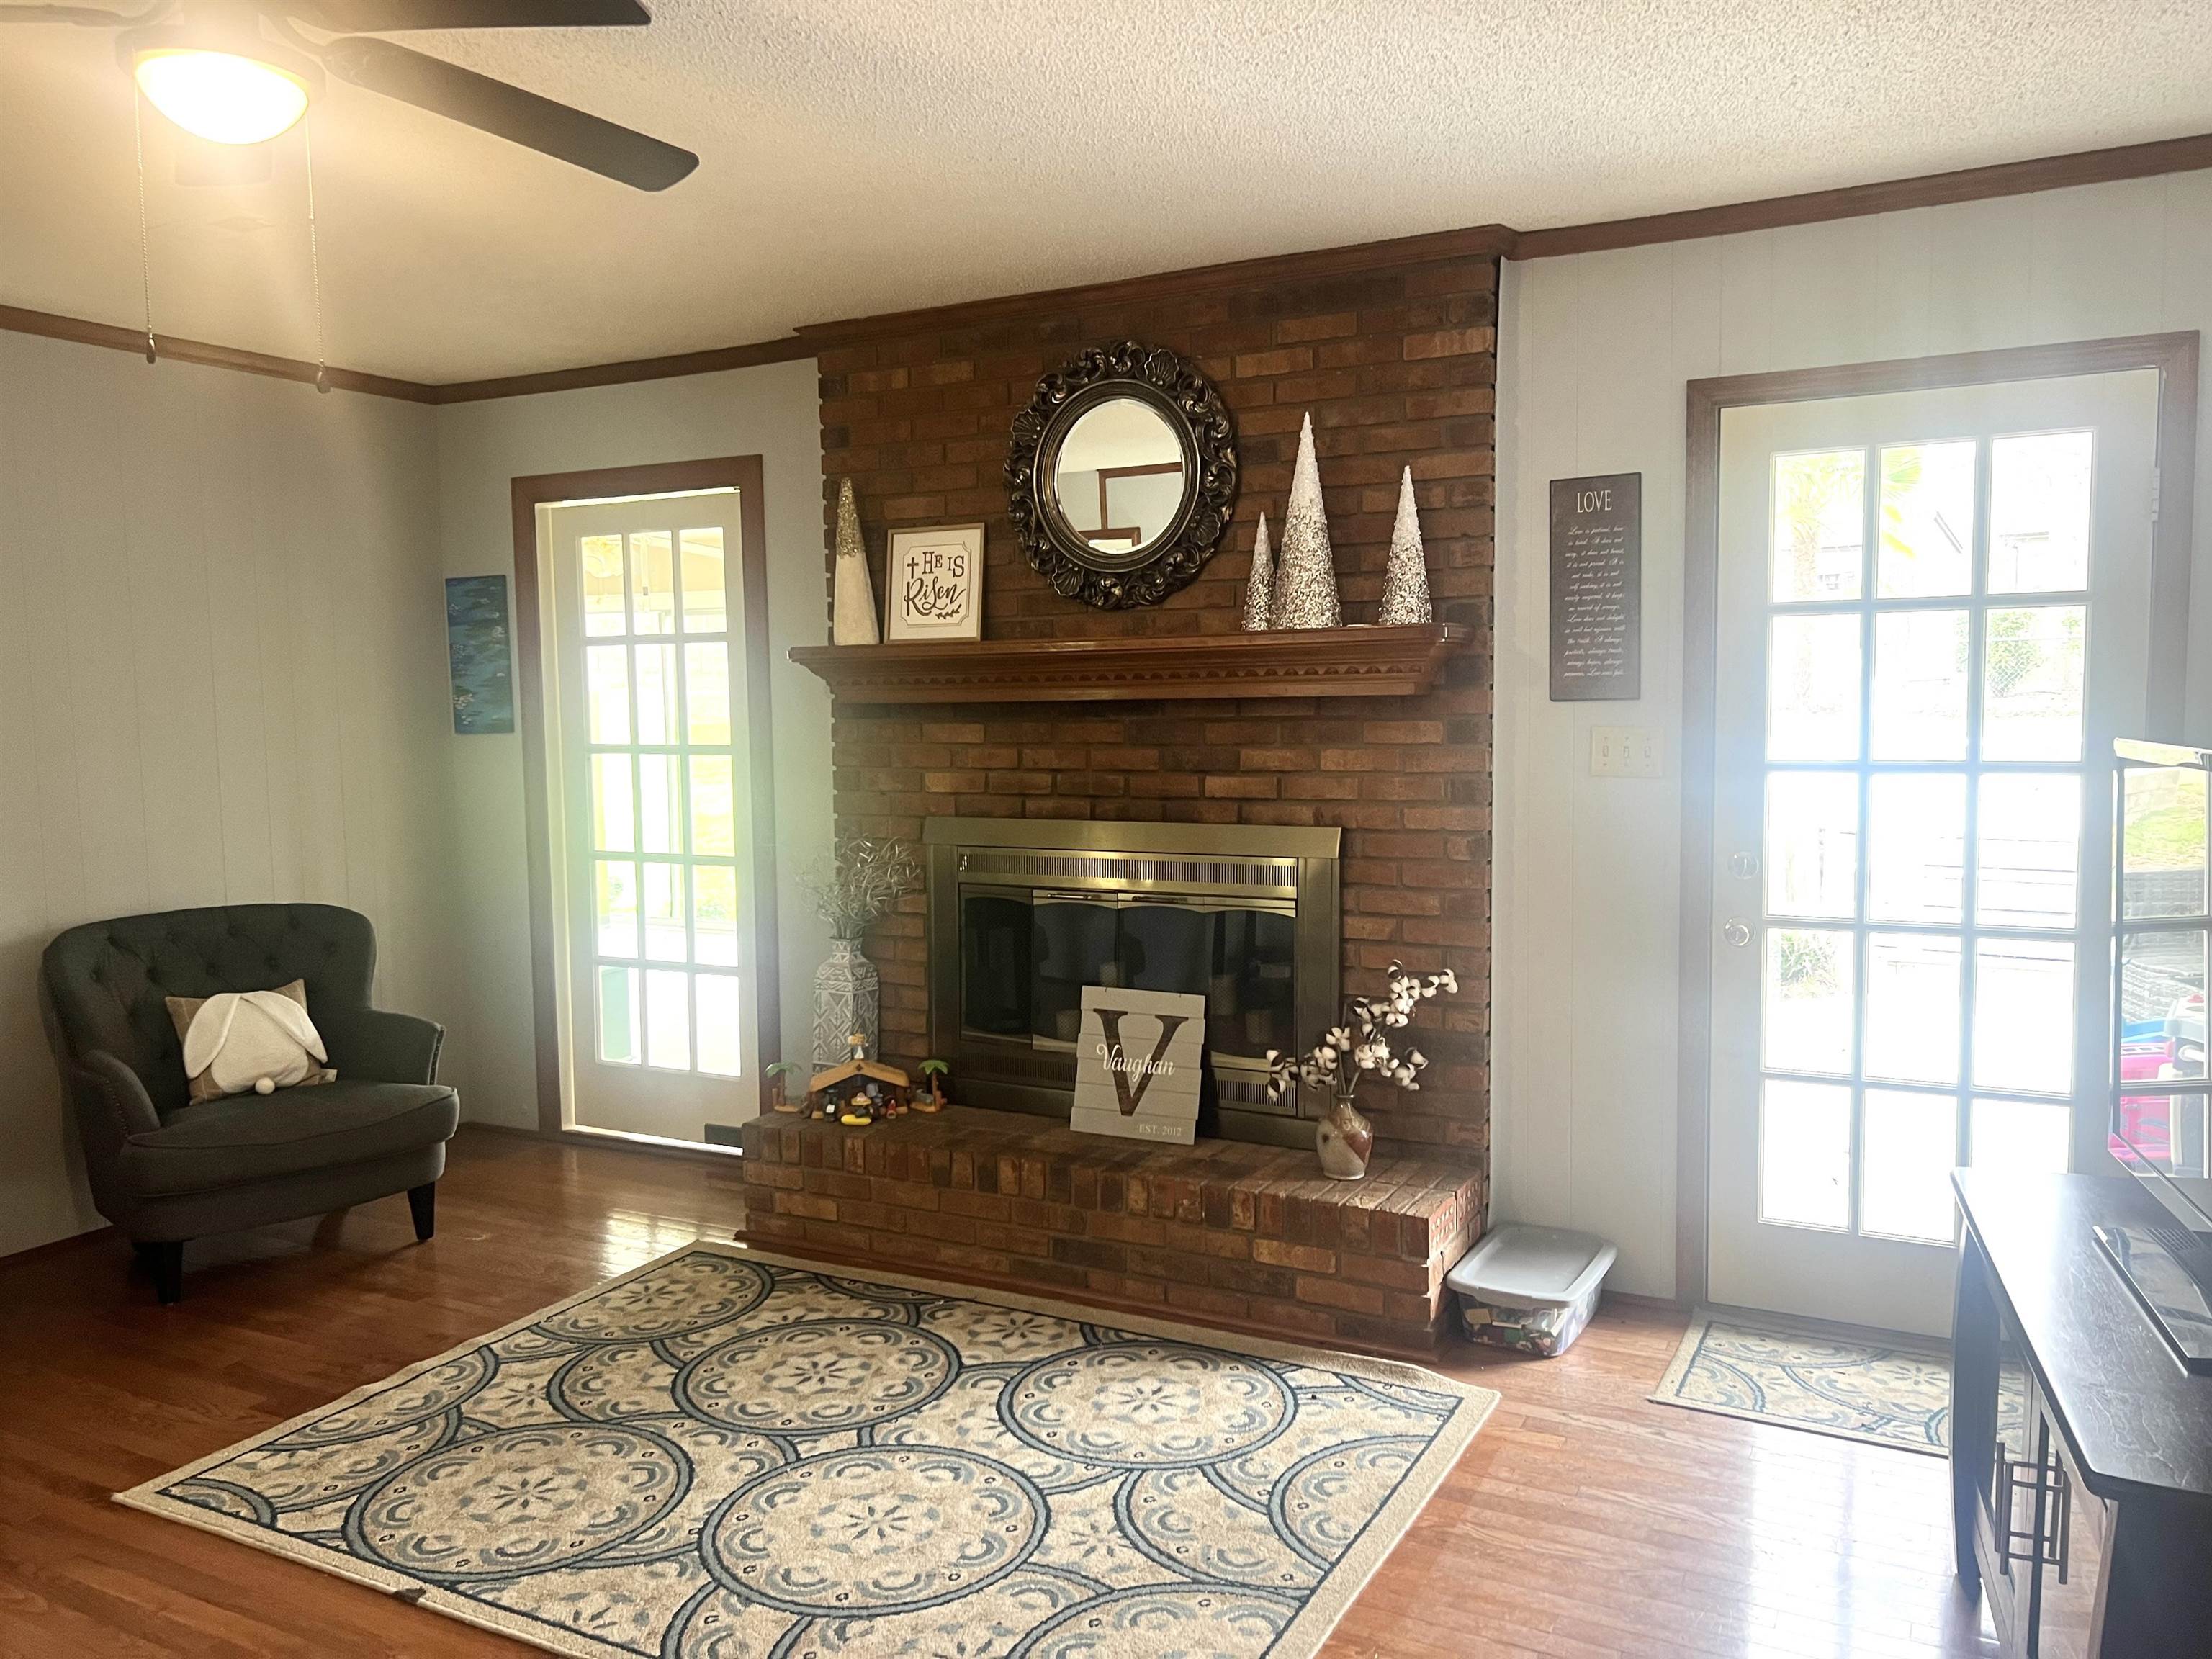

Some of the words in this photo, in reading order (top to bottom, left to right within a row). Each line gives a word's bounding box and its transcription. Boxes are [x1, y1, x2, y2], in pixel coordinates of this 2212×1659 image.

[1577, 490, 1613, 513] LOVE
[922, 552, 943, 575] HE
[947, 555, 965, 577] IS
[904, 576, 966, 617] Risen
[1093, 1008, 1189, 1116] V
[1097, 1043, 1176, 1082] Vaughan
[1139, 1123, 1159, 1136] EST.
